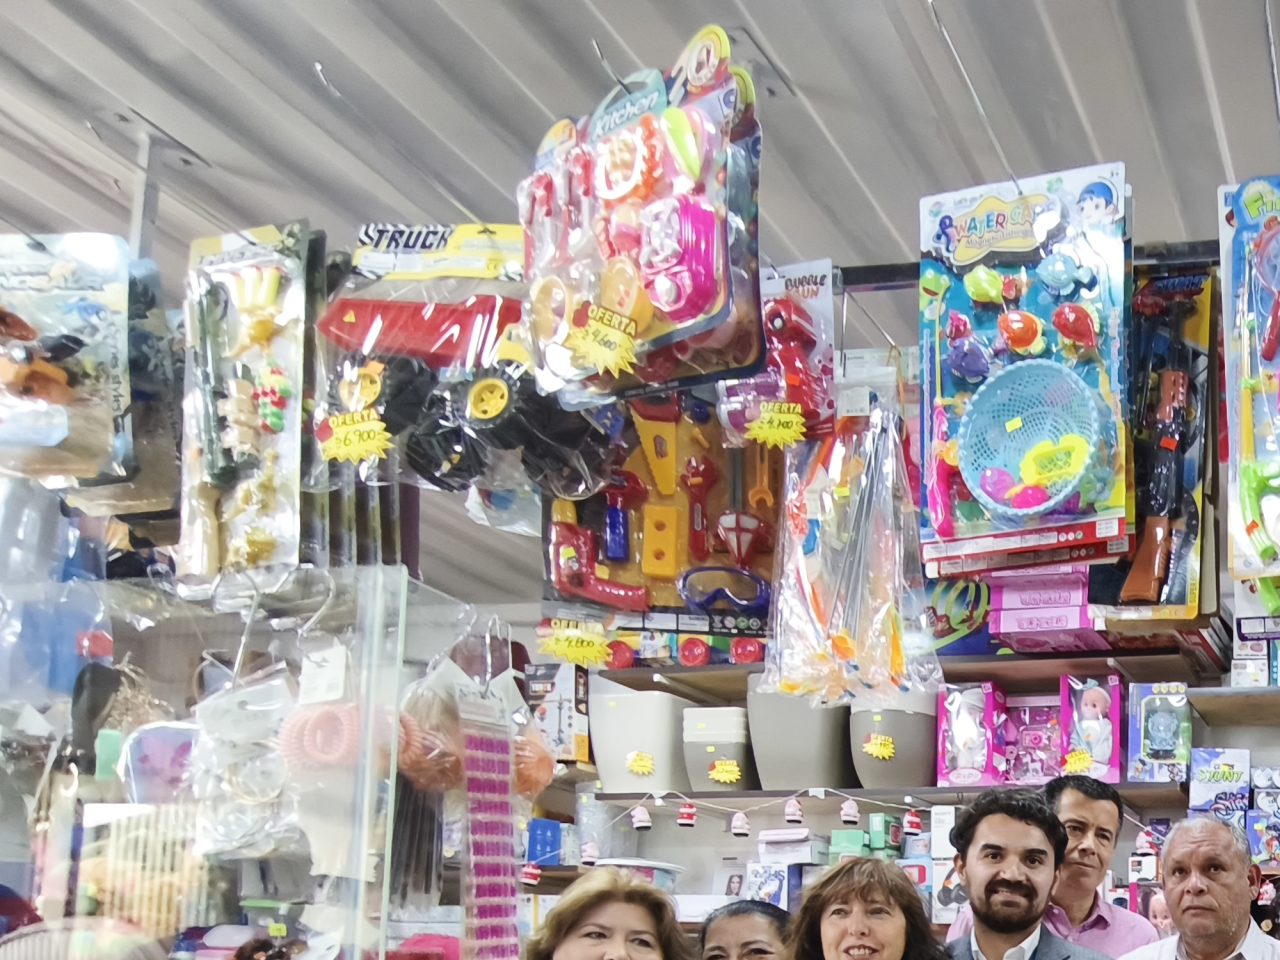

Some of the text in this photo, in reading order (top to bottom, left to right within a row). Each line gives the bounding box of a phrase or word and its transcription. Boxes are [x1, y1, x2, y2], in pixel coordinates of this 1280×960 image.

[953, 212, 1007, 242] WATER
[784, 274, 828, 291] BUBBLE
[587, 304, 639, 337] OFERTA
[759, 401, 803, 414] OFERTA
[328, 409, 380, 428] OFERTA
[1198, 769, 1244, 783] STUNT
